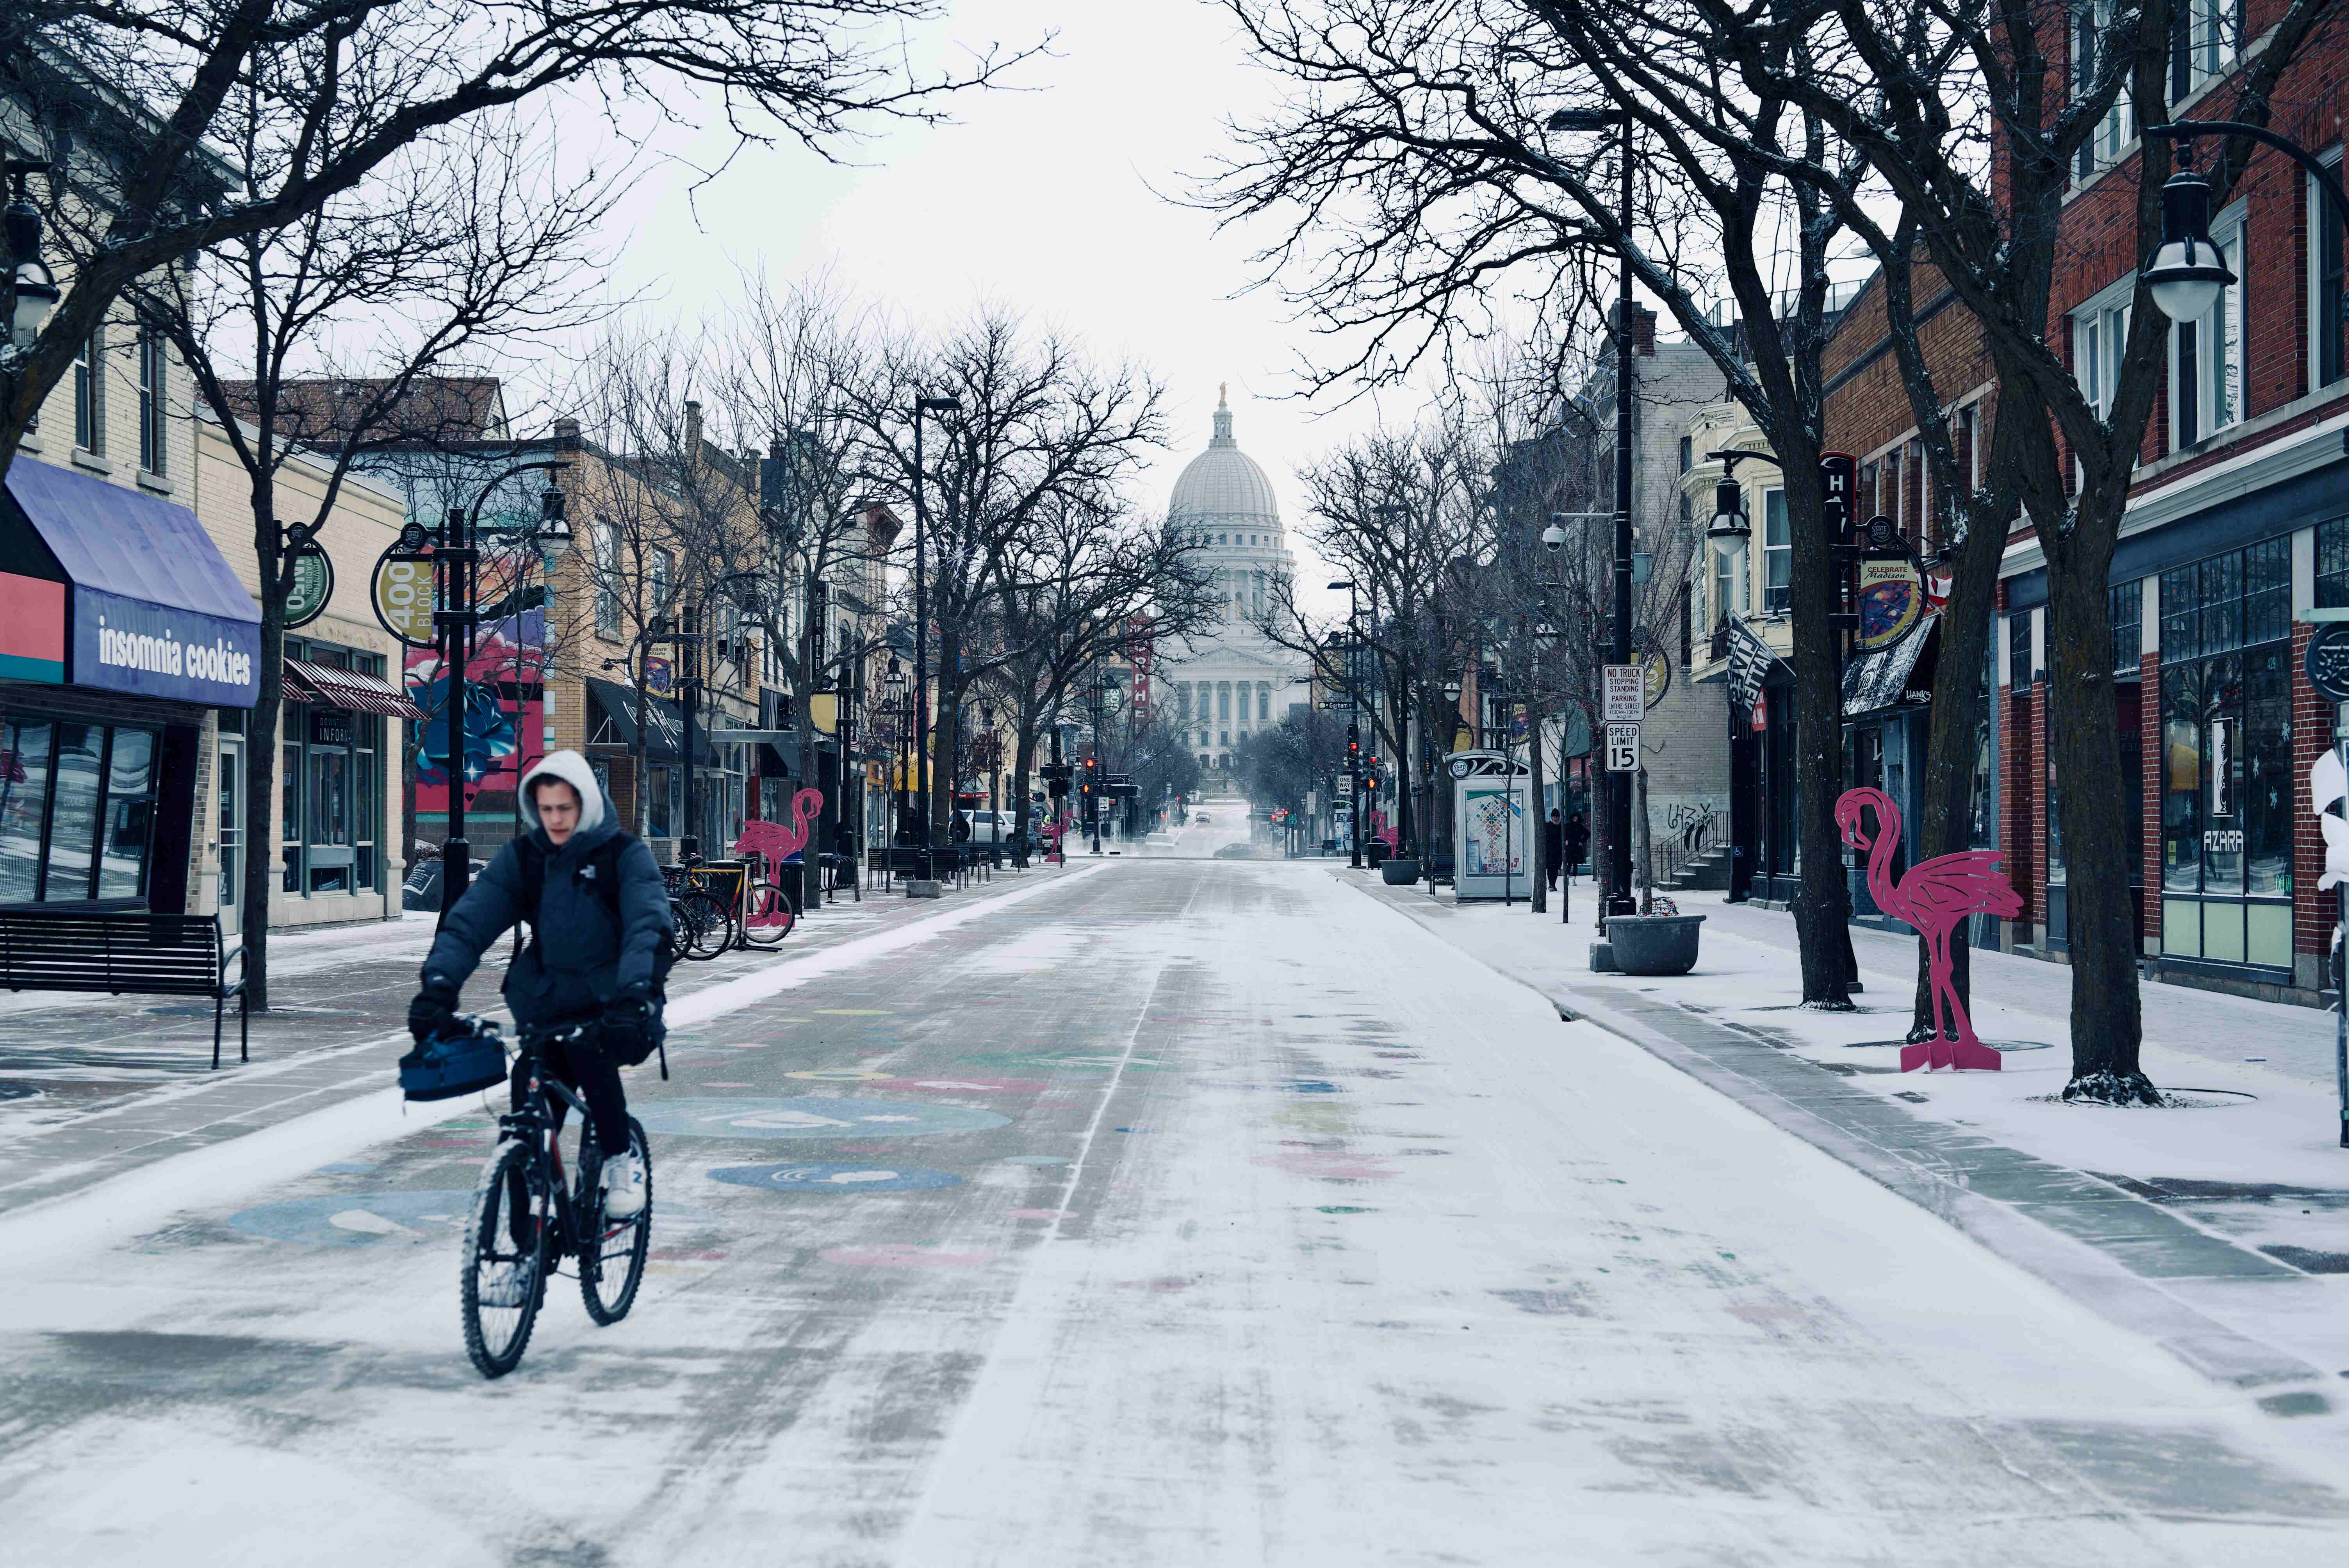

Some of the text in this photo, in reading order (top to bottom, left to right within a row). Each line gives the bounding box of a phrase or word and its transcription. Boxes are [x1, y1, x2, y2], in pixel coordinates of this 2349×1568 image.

[388, 561, 415, 628] 400
[417, 576, 431, 627] BLOCK
[99, 615, 250, 686] insomnia cookies
[1608, 668, 1640, 678] NO TRUCK
[1906, 690, 1932, 701] HAWKS
[1609, 727, 1637, 736] SPEED
[1612, 737, 1634, 745] LIMIT
[1611, 748, 1634, 768] 15
